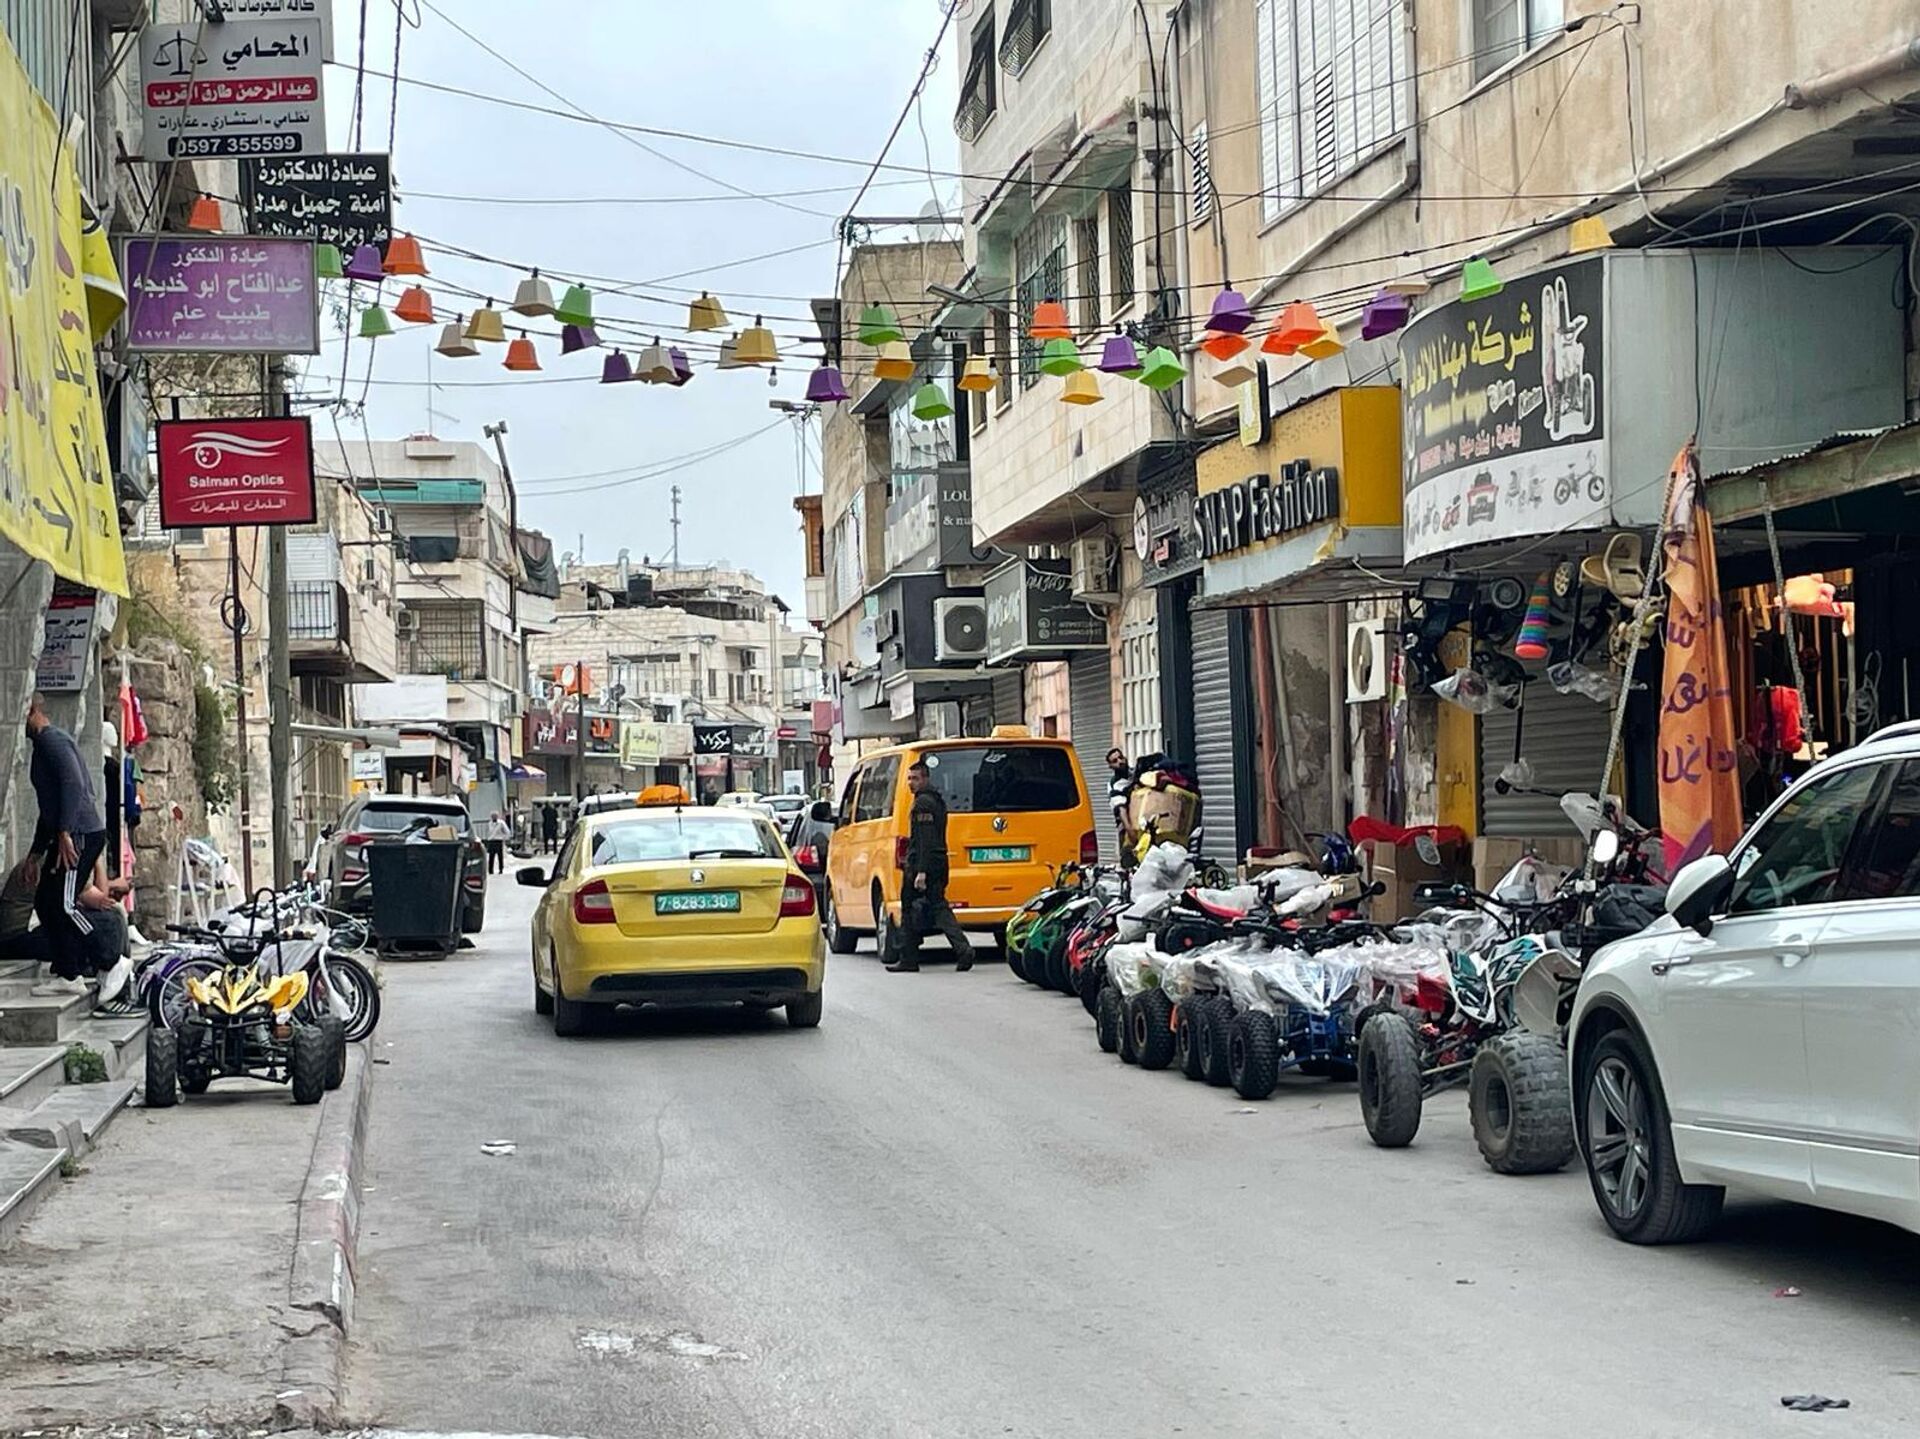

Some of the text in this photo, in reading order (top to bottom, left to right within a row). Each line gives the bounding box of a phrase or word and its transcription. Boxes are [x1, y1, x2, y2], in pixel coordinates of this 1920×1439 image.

[222, 34, 309, 71] المحامي
[201, 82, 233, 102] طارق
[236, 81, 283, 101] الرحمن
[285, 82, 312, 99] عبد
[227, 136, 296, 152] 355599
[258, 158, 377, 186] عيادة الدكتورة
[291, 193, 341, 218] جميل
[172, 247, 269, 267] عيادة الدكتور
[172, 304, 271, 327] طبيب عام
[1467, 301, 1535, 371] شركة
[189, 474, 284, 488] Salman Optics
[1193, 484, 1246, 560] SNAP
[1248, 460, 1332, 542] Fashion
